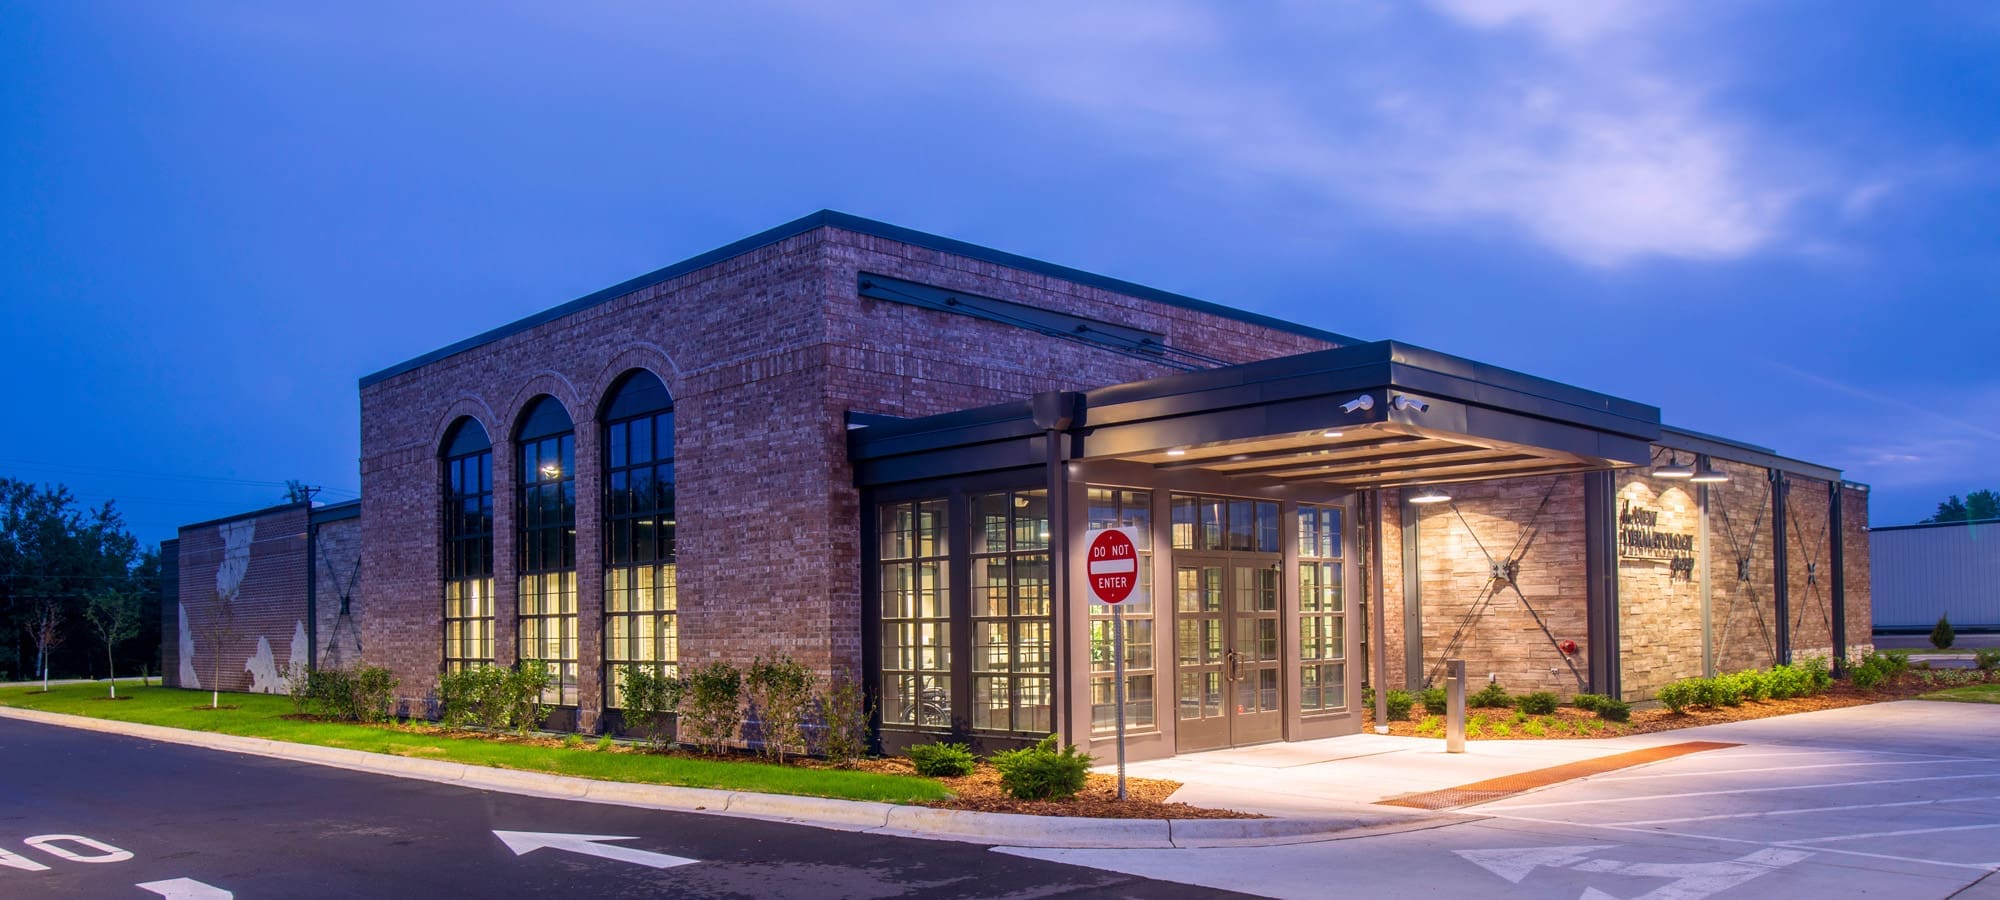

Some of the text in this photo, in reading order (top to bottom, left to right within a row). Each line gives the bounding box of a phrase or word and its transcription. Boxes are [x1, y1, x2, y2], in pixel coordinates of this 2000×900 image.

[1094, 544, 1129, 558] DO NOT
[1098, 576, 1127, 589] ENTER
